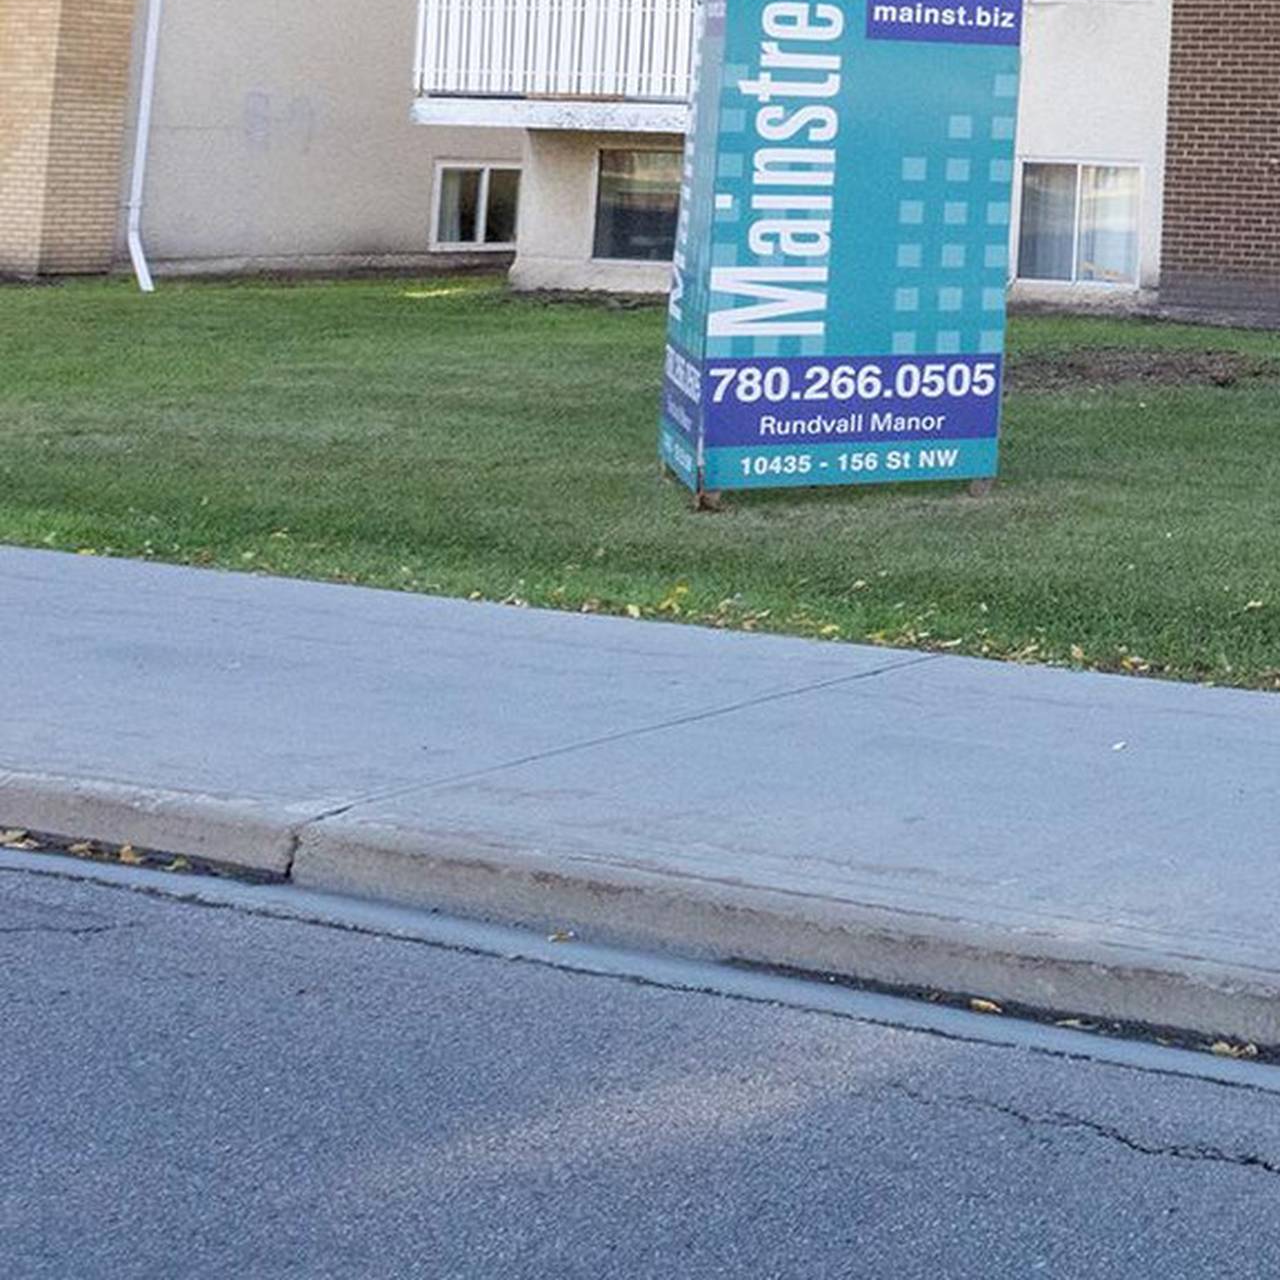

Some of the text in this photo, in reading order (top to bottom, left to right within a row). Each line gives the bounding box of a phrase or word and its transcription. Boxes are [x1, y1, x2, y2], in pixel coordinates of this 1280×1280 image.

[873, 2, 1015, 29] mainst.biz
[709, 363, 995, 402] 780.266.0505
[759, 412, 945, 435] Rundvall Manor
[741, 455, 811, 475] 10435
[838, 452, 878, 472] 156
[886, 451, 910, 471] St
[919, 449, 958, 469] NW
